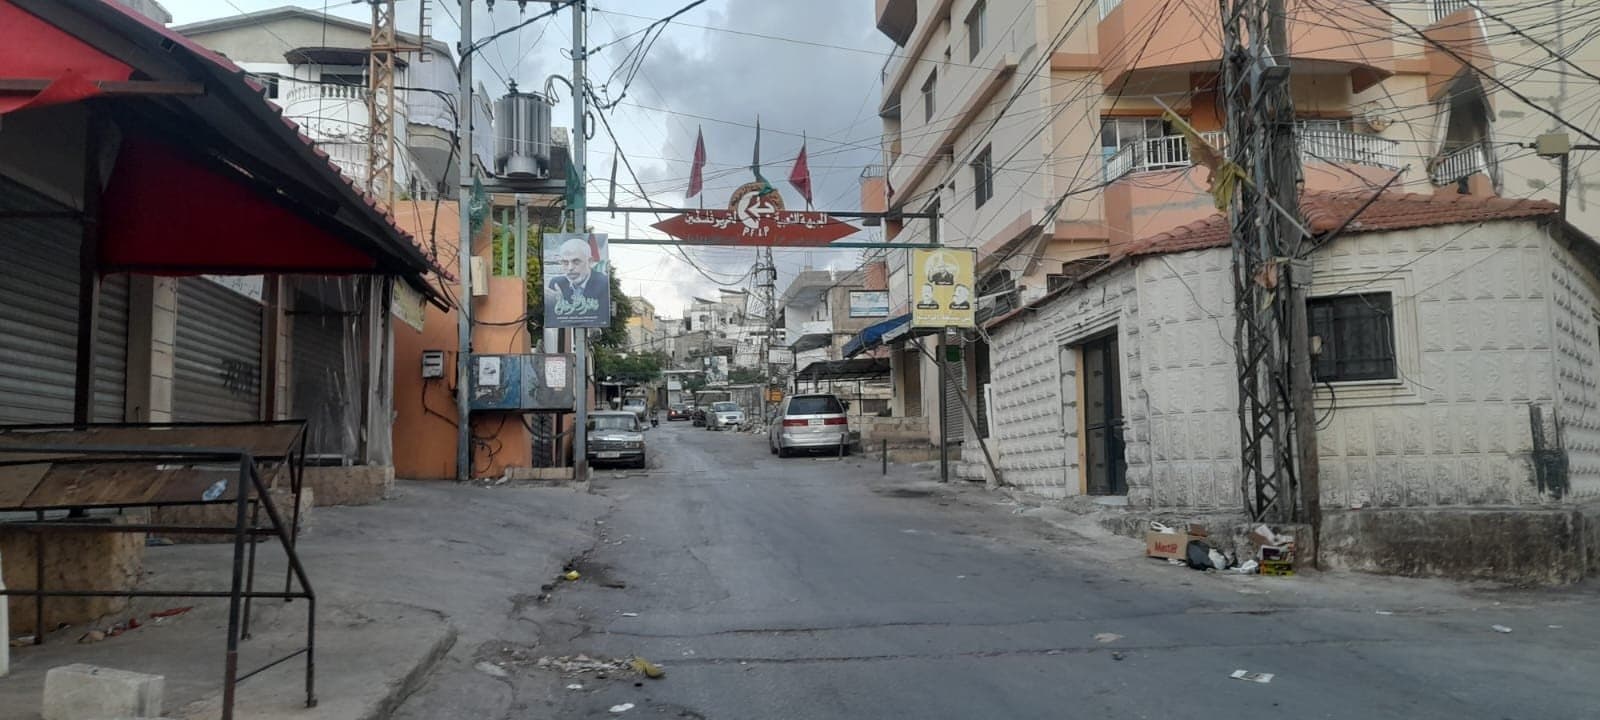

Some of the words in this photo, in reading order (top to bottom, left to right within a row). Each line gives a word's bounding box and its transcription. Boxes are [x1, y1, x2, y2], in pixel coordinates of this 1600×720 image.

[684, 209, 715, 224] فلسطين
[712, 210, 737, 229] لتحرير
[774, 211, 800, 228] الشعبية
[799, 212, 828, 228] الجبهة
